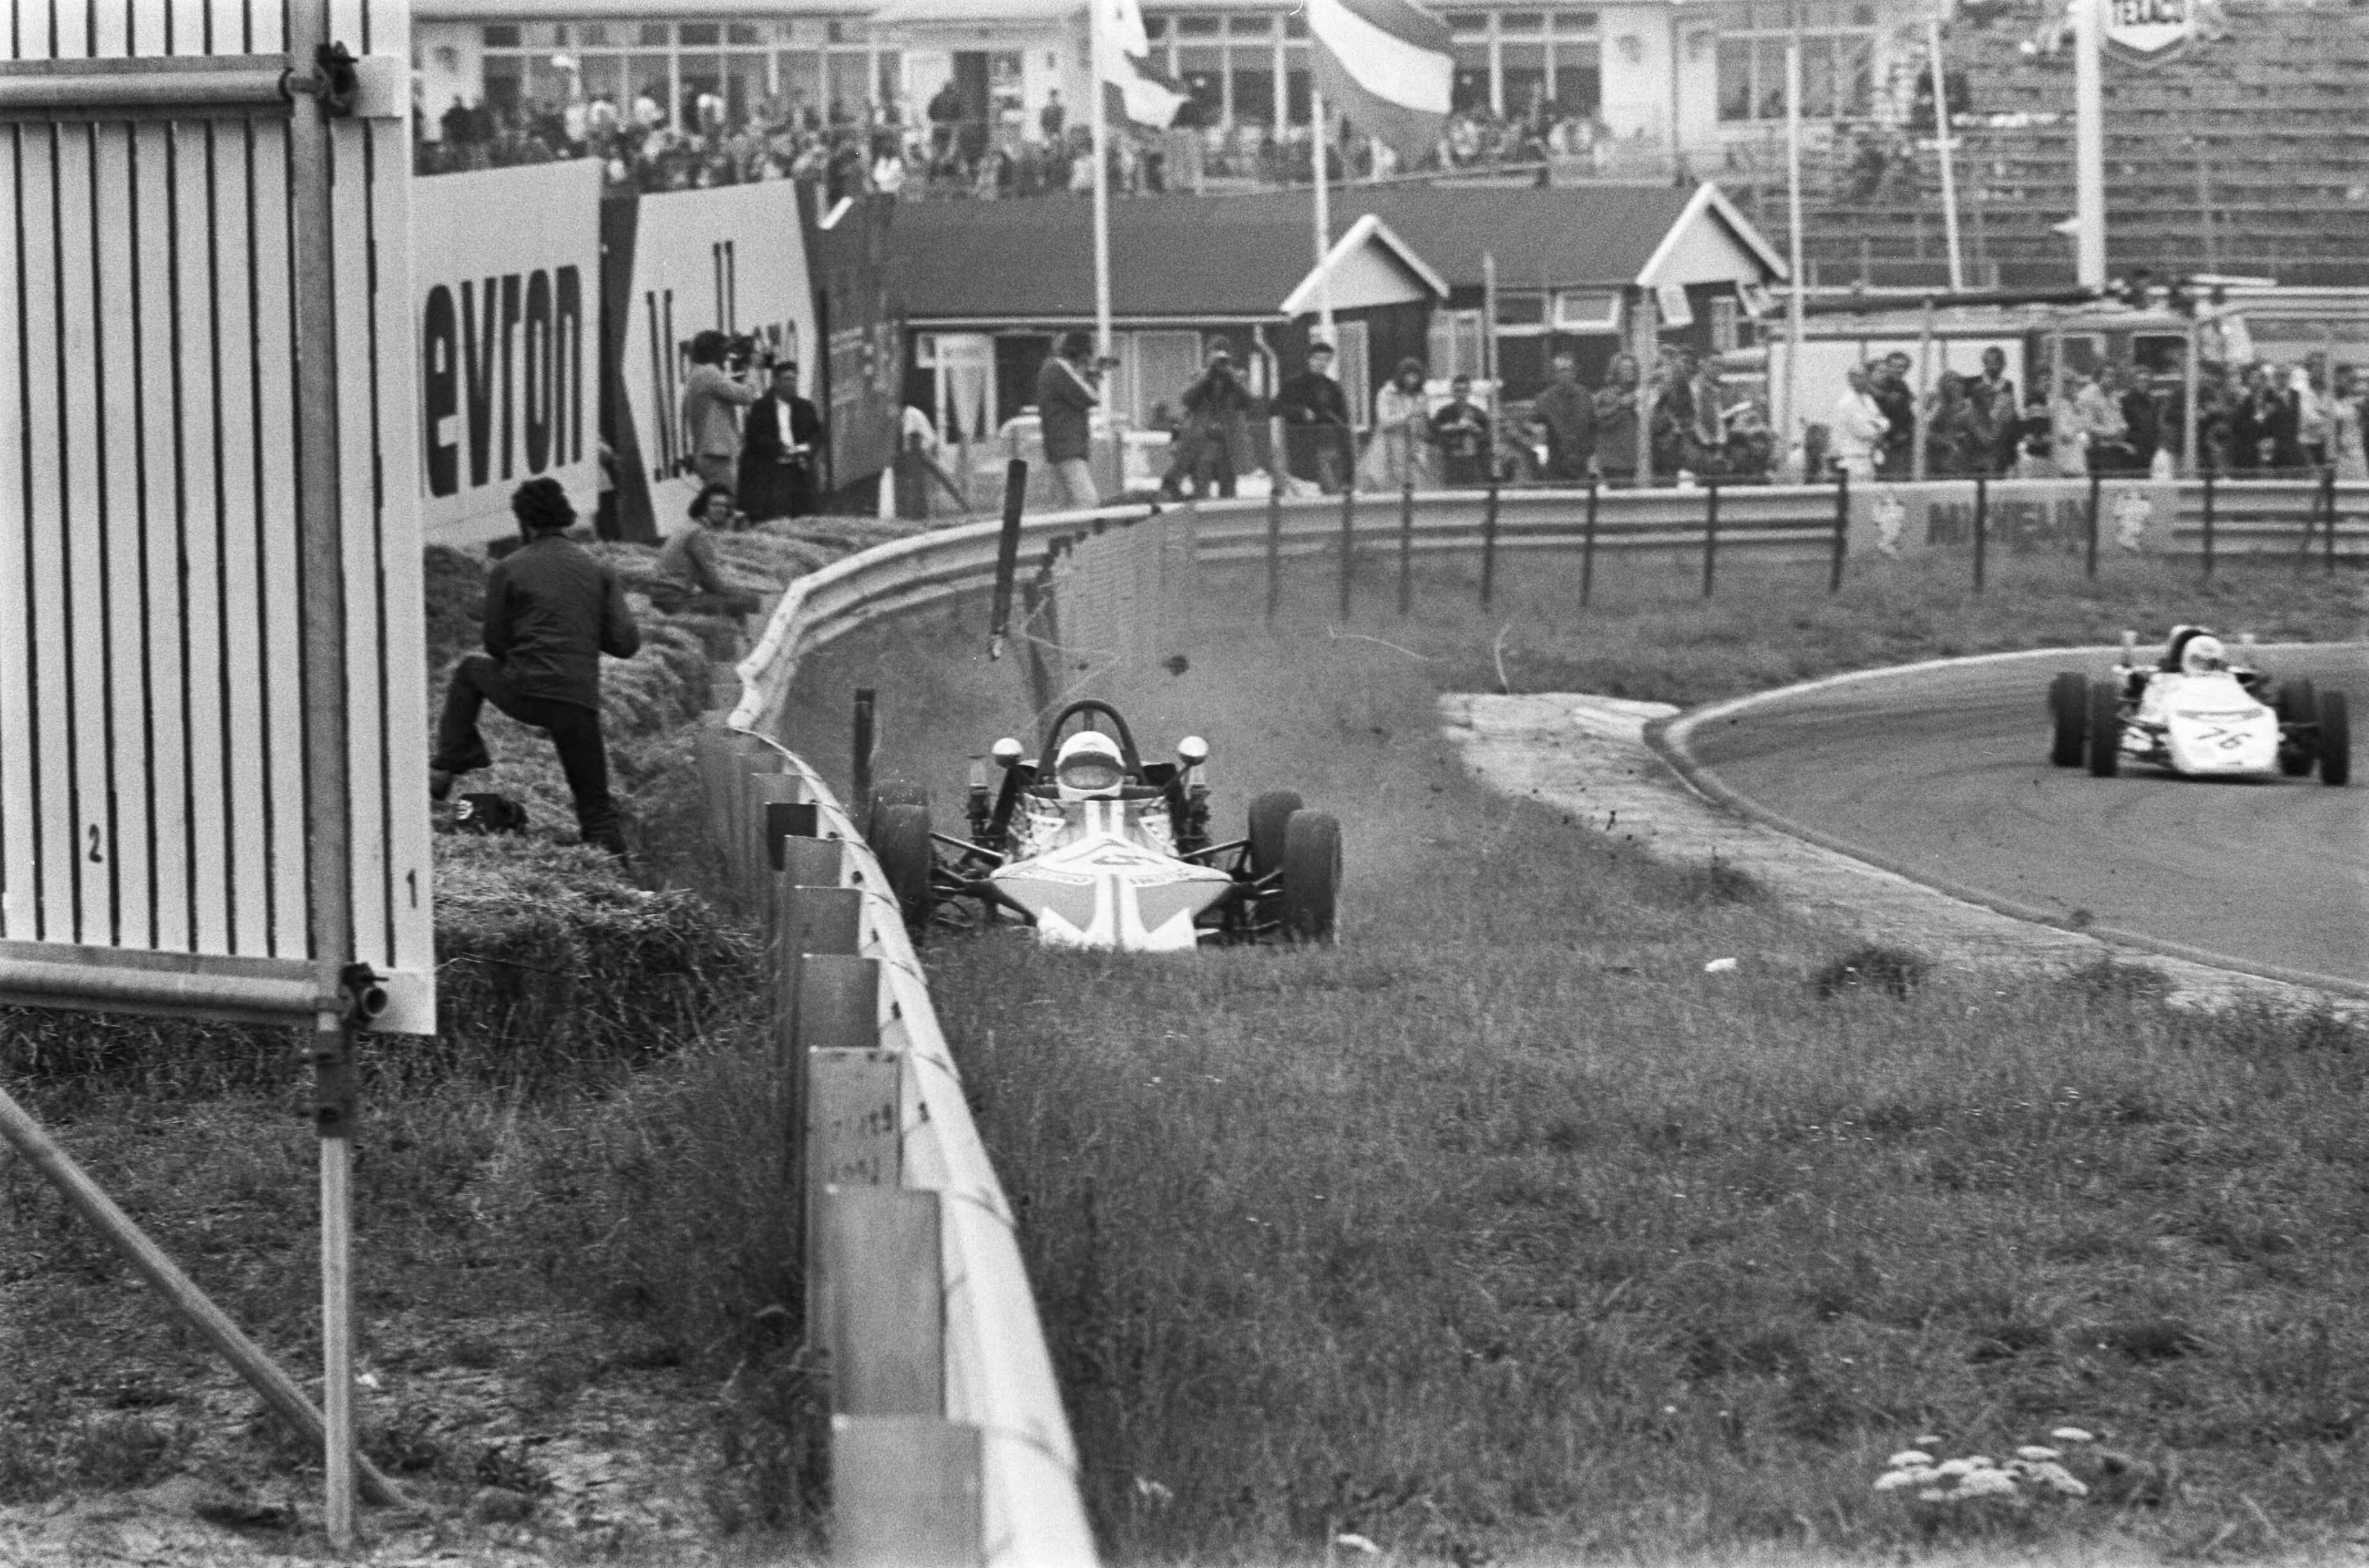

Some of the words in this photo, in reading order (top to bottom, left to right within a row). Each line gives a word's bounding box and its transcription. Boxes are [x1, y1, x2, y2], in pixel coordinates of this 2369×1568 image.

[417, 264, 583, 498] evron
[88, 824, 103, 863] 2
[406, 868, 418, 909] 1
